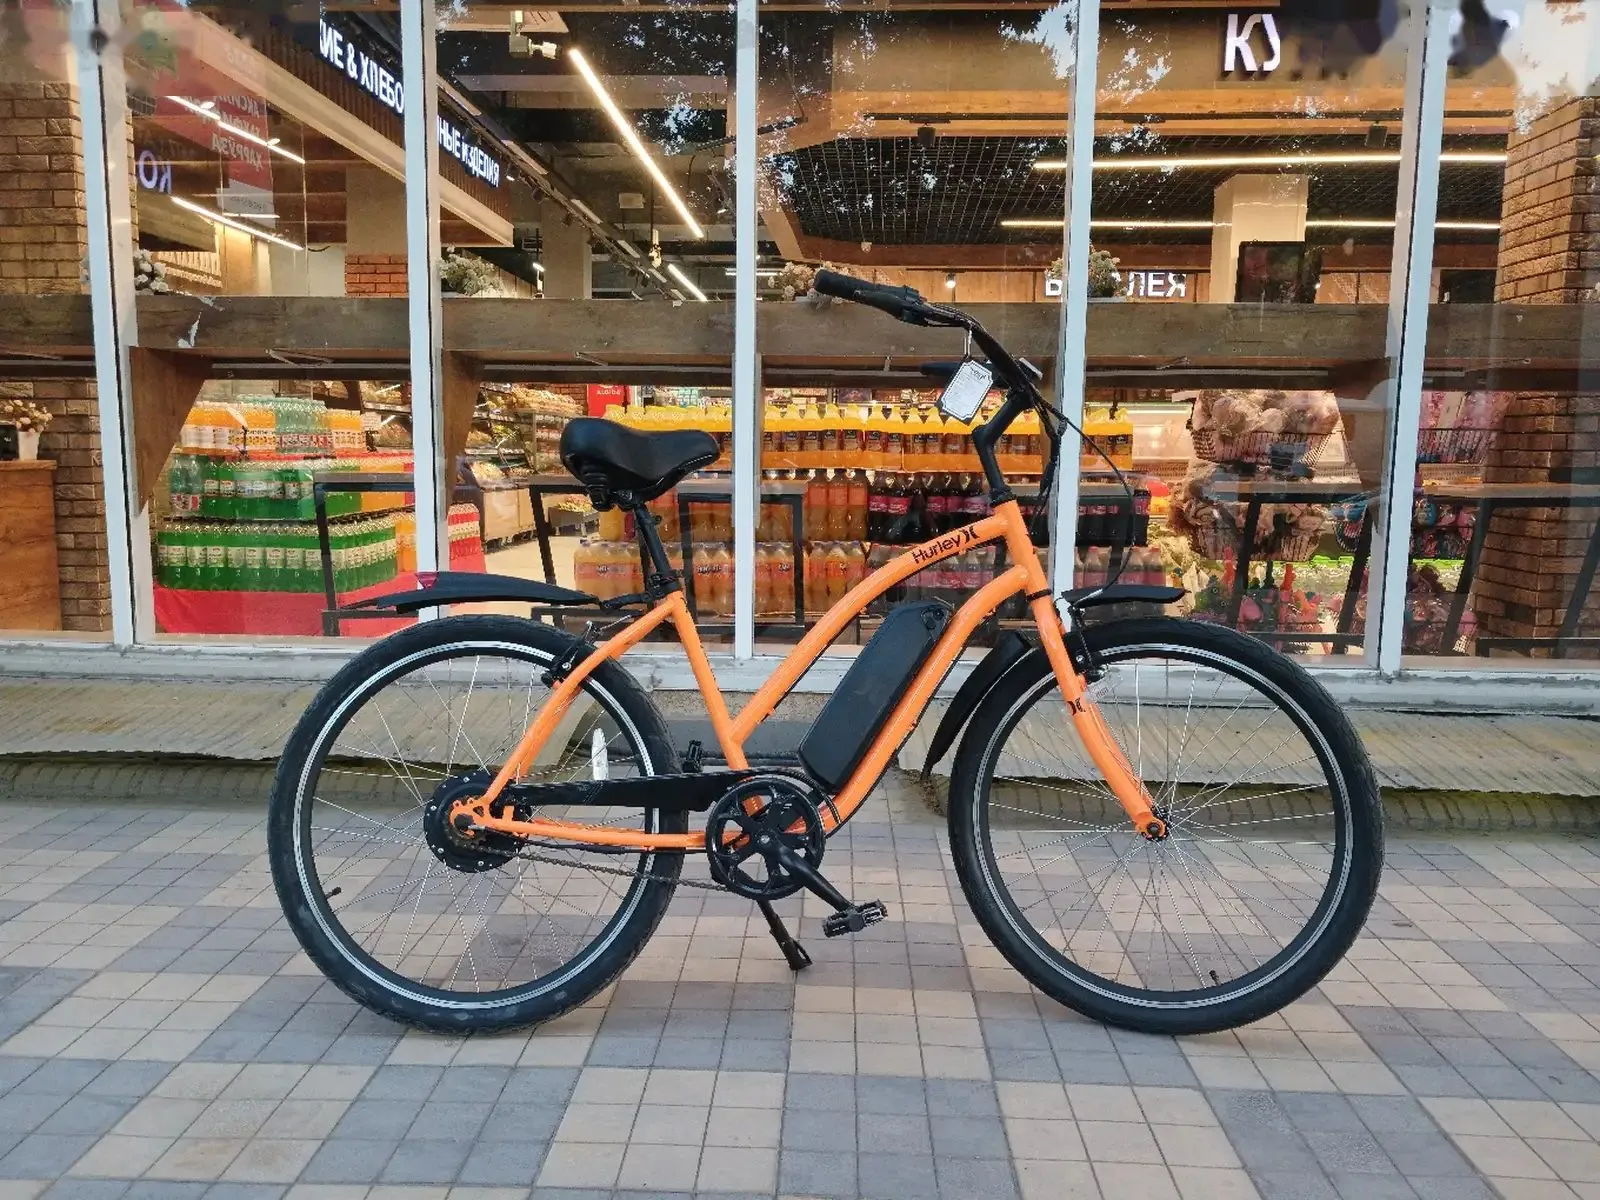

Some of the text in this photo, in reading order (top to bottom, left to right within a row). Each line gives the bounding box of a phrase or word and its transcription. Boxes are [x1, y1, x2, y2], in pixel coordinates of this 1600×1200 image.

[346, 42, 358, 80] &
[462, 141, 500, 188] ИЗДЕЛИЯ
[912, 534, 961, 564] Hurley
